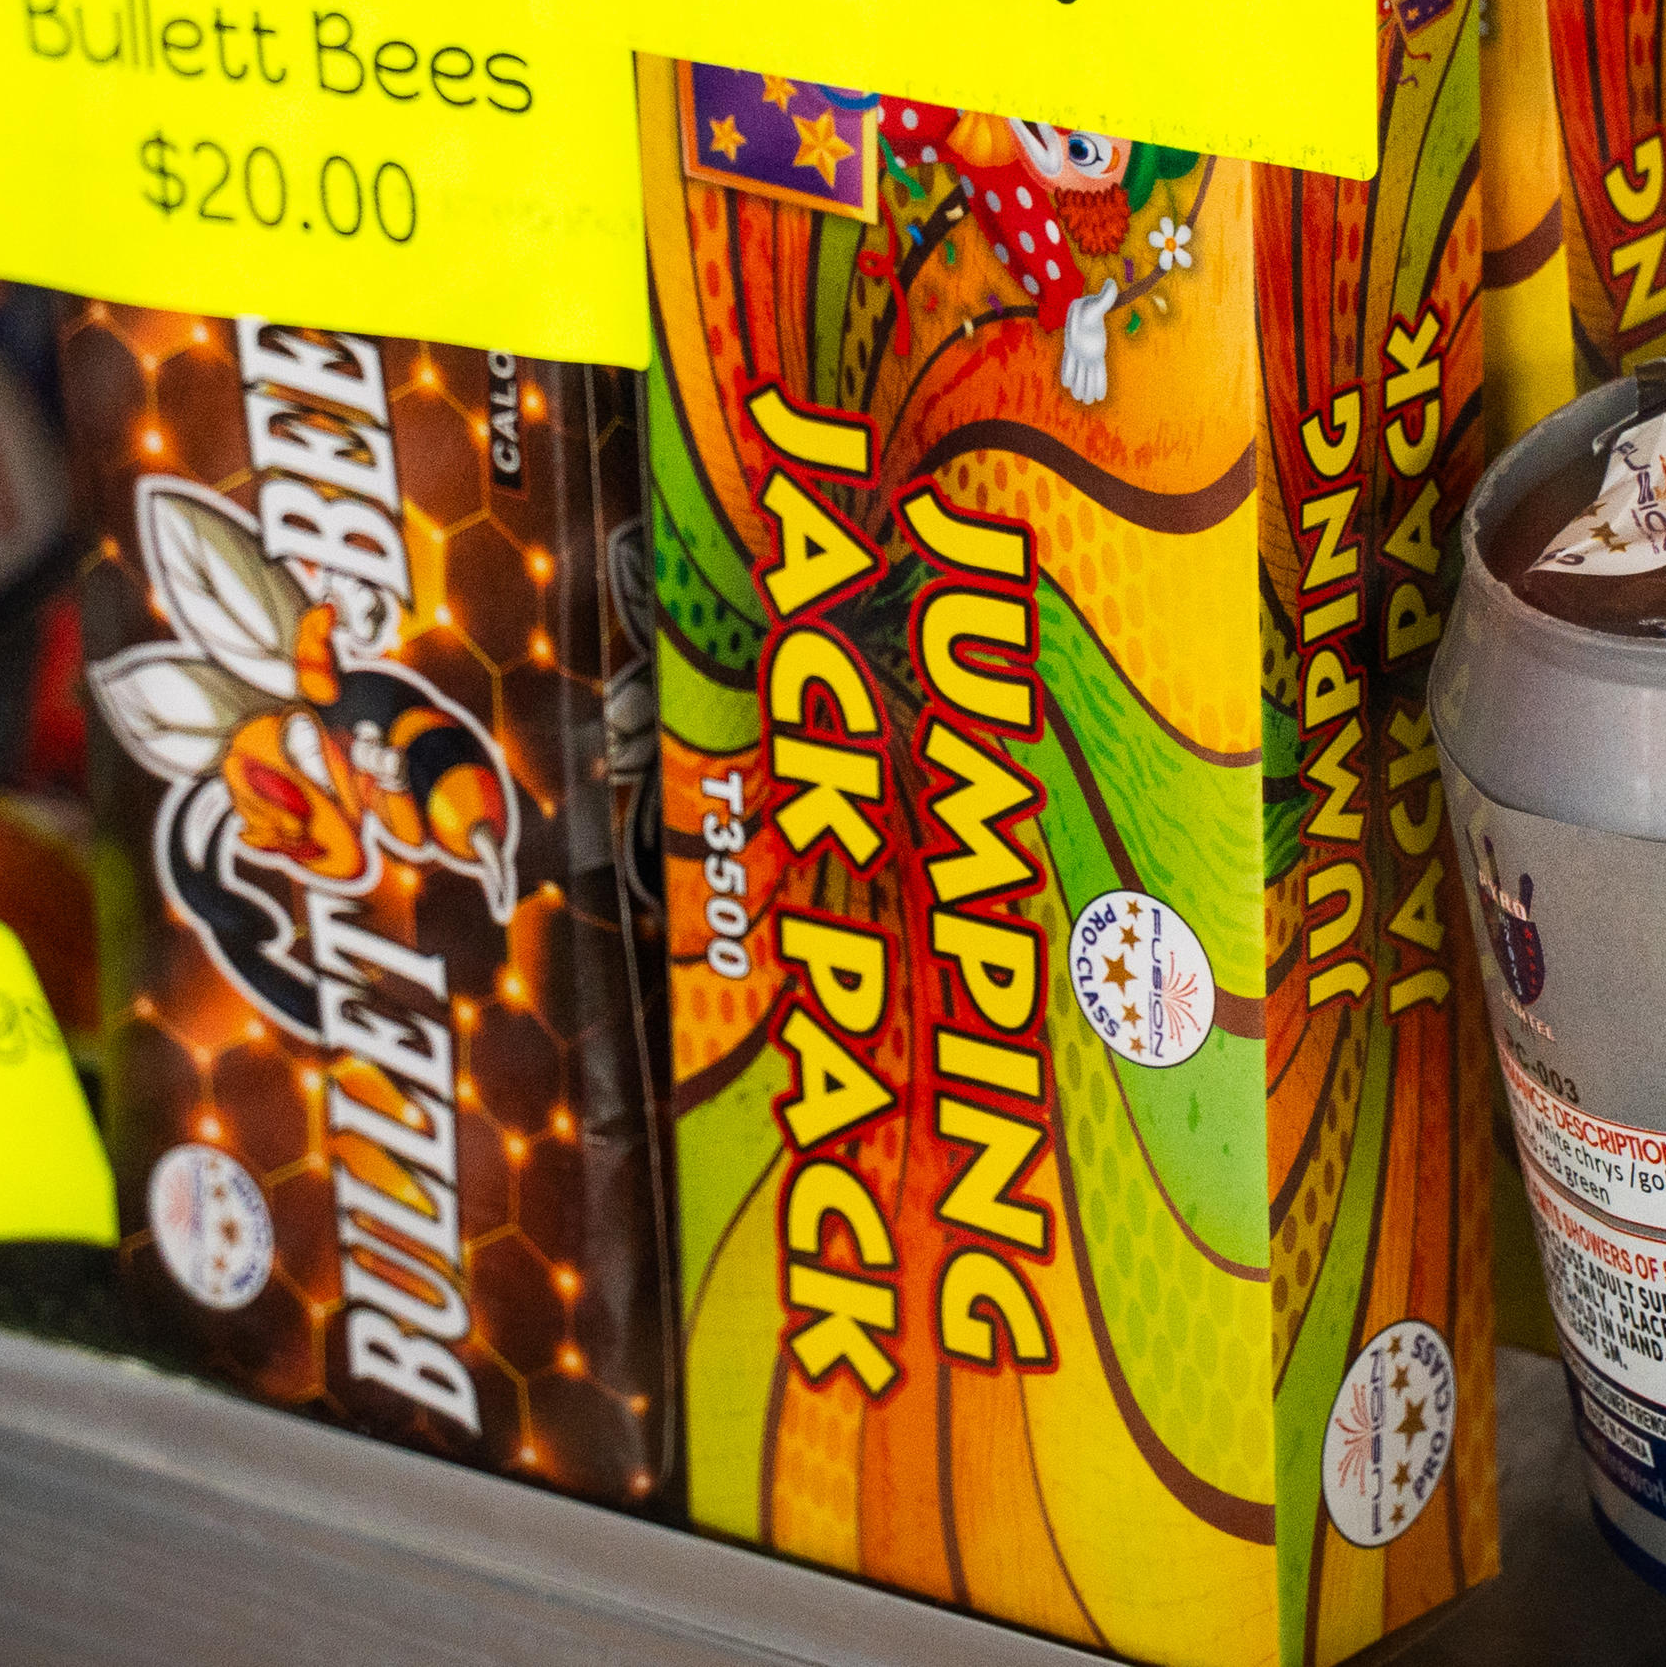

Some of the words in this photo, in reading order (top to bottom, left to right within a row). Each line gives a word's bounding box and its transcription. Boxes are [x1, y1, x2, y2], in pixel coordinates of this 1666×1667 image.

[313, 8, 534, 115] Bees
[139, 128, 418, 246] $20.00
[1381, 308, 1443, 662] PACK
[745, 382, 884, 870] JACK
[1299, 386, 1373, 1015] JUMPING
[700, 770, 751, 980] T3500
[902, 482, 1057, 1368] JUMPING
[1386, 704, 1452, 1017] JACK
[1074, 901, 1122, 1038] PRO-CLASS
[1149, 907, 1166, 1059] FUSION
[302, 883, 482, 1438] BULLET
[775, 910, 904, 1401] PACK
[1564, 1163, 1612, 1205] green
[1574, 1145, 1625, 1183] chrys
[1562, 1212, 1633, 1275] SHOWERS
[1635, 1252, 1658, 1282] OF
[1589, 1261, 1636, 1305] ADULT
